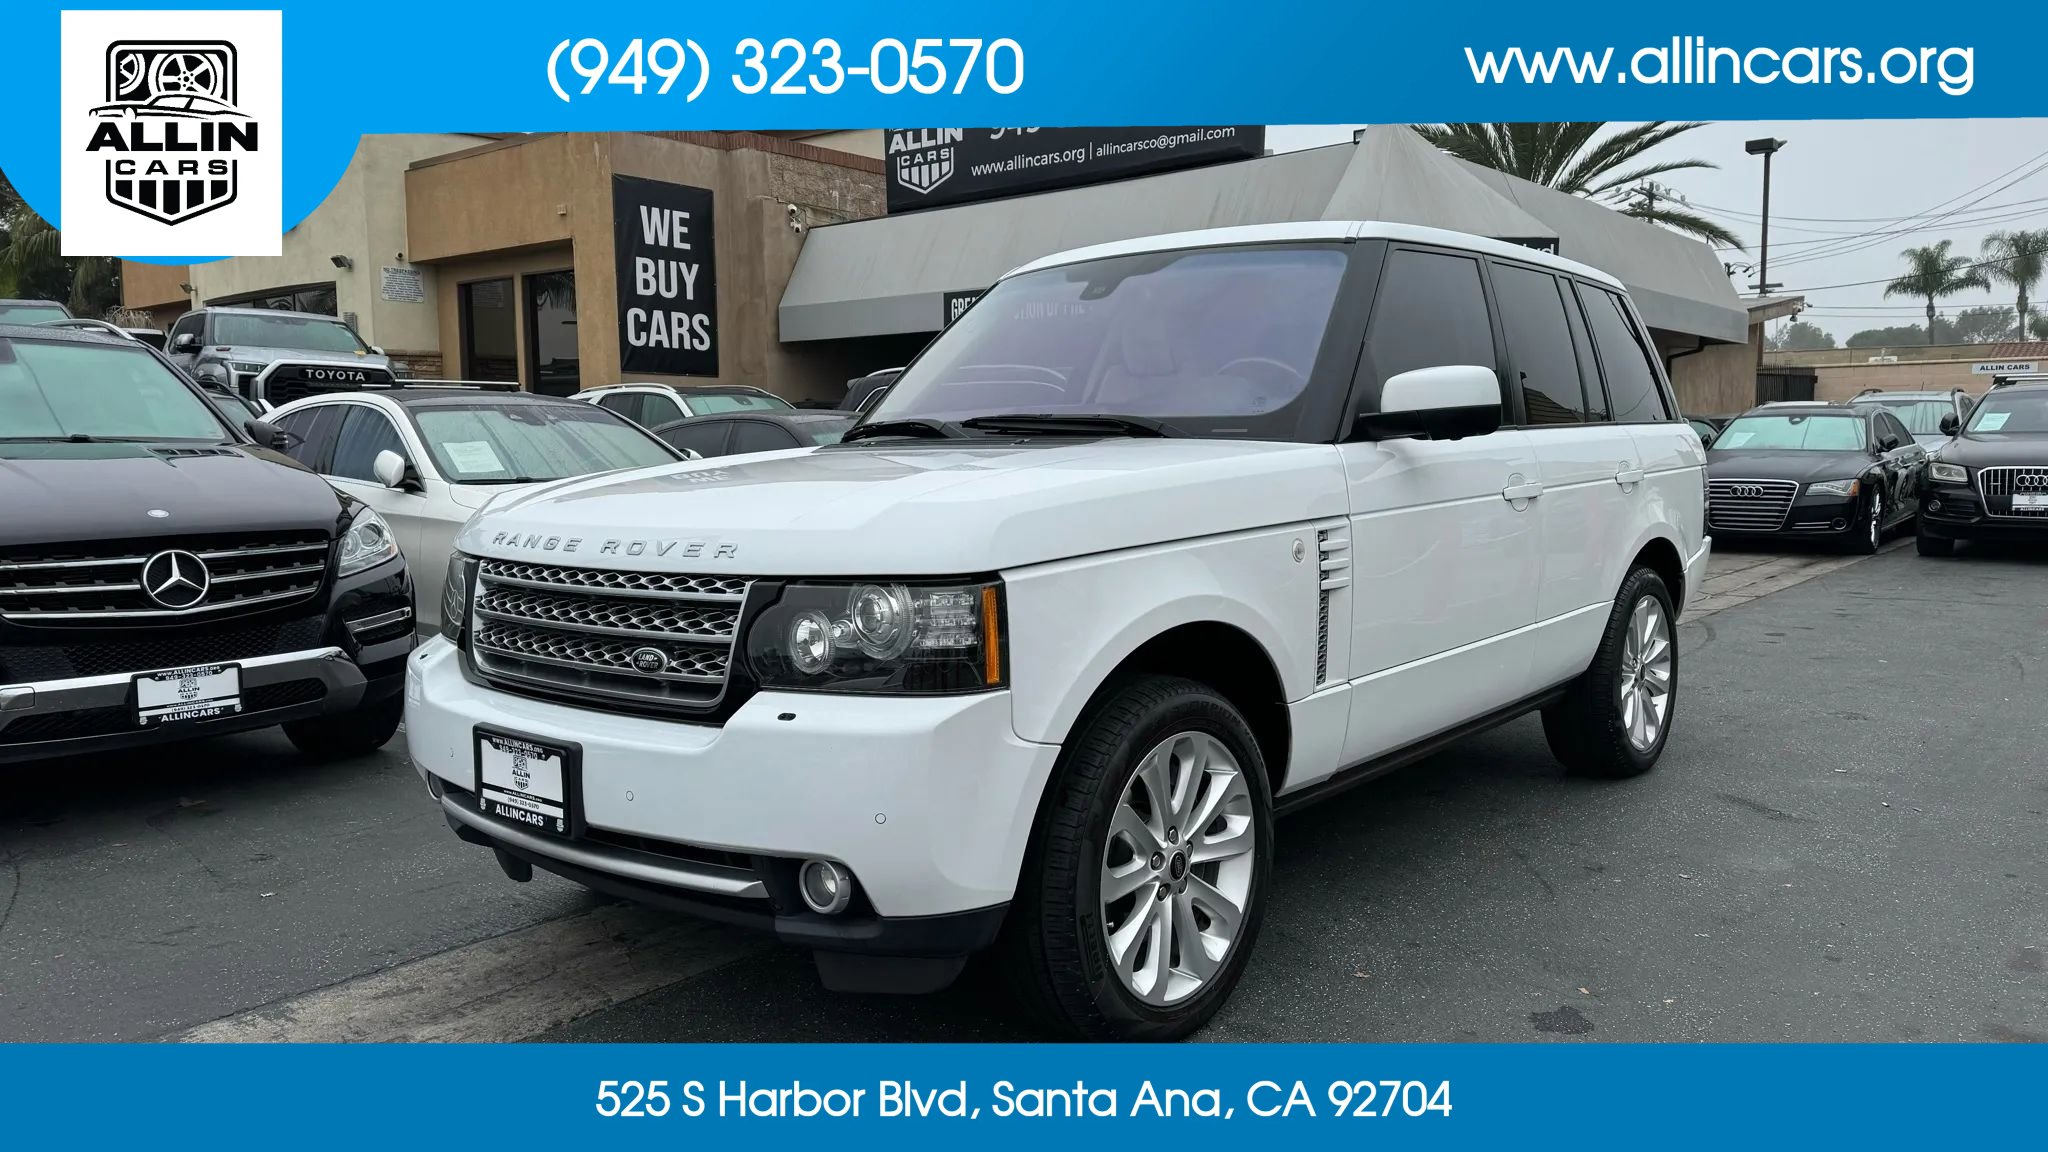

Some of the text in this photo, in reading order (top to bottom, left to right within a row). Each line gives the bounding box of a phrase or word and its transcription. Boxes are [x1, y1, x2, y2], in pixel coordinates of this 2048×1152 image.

[888, 128, 963, 154] ALLIN
[970, 146, 1085, 177] www.allincars.org
[1096, 126, 1235, 157] allincarsco@gmail.com
[900, 148, 950, 167] CARS
[639, 205, 691, 250] WE
[635, 256, 699, 300] BUY
[626, 307, 711, 352] CARS
[305, 369, 366, 381] TOYOTA
[492, 531, 738, 559] RANGE ROVER
[160, 707, 221, 723] ALLINCARS
[512, 769, 530, 779] ALLIN
[495, 803, 544, 827] ALLINCARS
